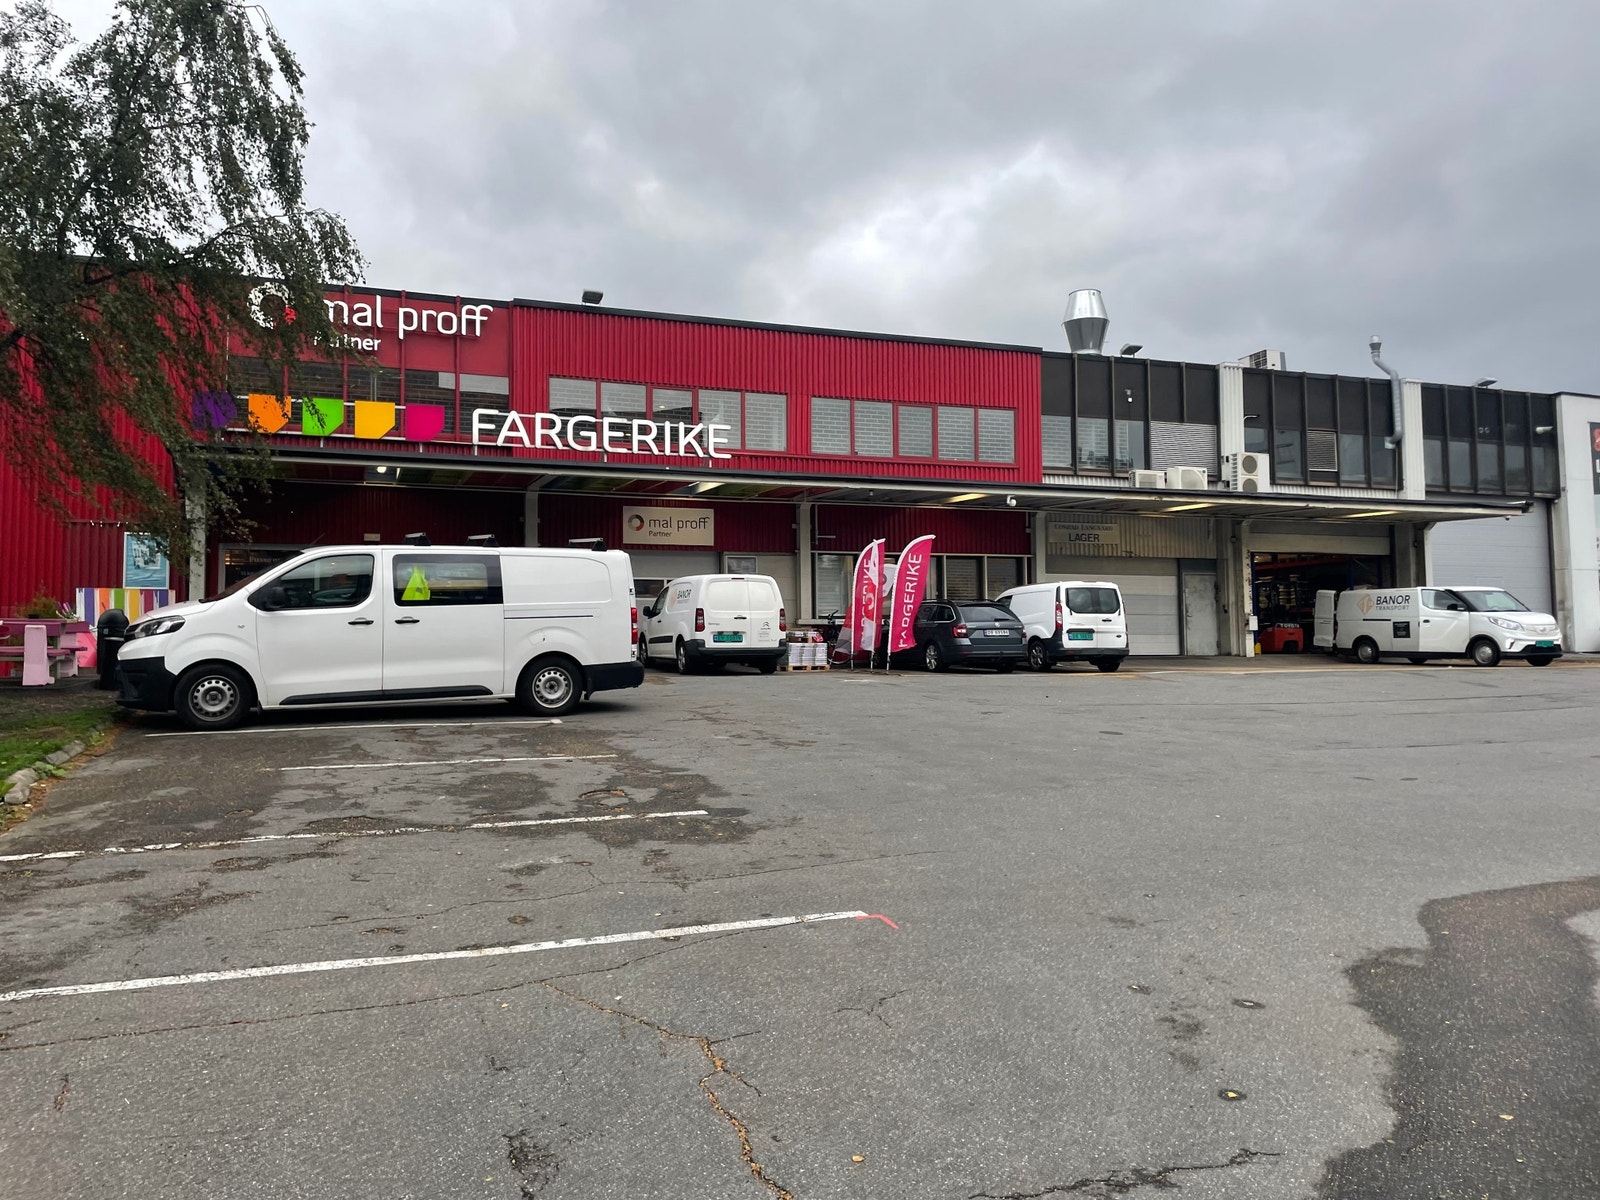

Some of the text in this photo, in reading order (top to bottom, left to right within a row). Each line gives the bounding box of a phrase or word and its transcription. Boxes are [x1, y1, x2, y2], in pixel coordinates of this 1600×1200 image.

[321, 294, 494, 340] mal proff
[313, 330, 382, 351] tner
[472, 408, 732, 459] FARGERIKE
[648, 516, 711, 532] mal proff
[1068, 533, 1100, 542] LAGER
[1376, 595, 1410, 605] BANOR
